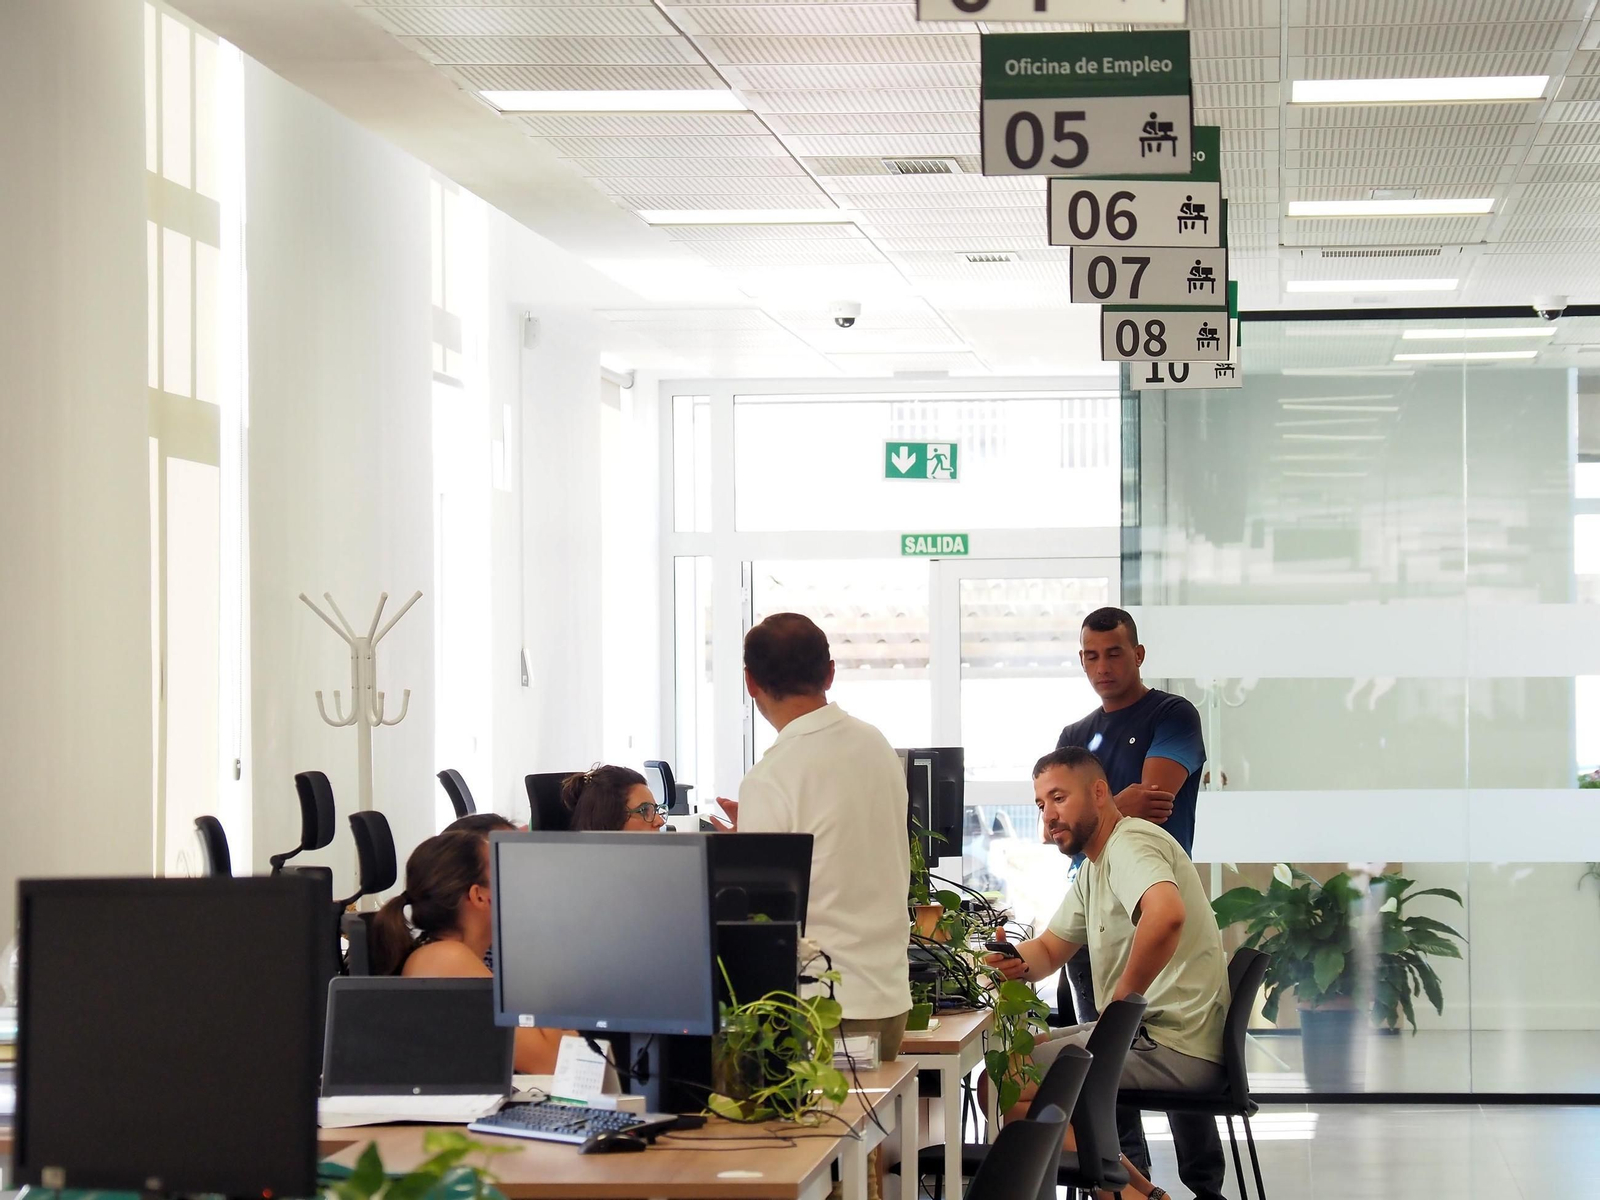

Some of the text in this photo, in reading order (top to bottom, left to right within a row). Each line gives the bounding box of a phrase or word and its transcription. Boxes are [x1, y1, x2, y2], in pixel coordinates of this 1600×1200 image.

[1005, 56, 1173, 77] Oficina de Empleo
[1005, 110, 1089, 170] 05
[1068, 190, 1138, 241] 06
[1087, 255, 1151, 300] 07
[1115, 319, 1167, 357] 08
[904, 536, 965, 553] SALIDA
